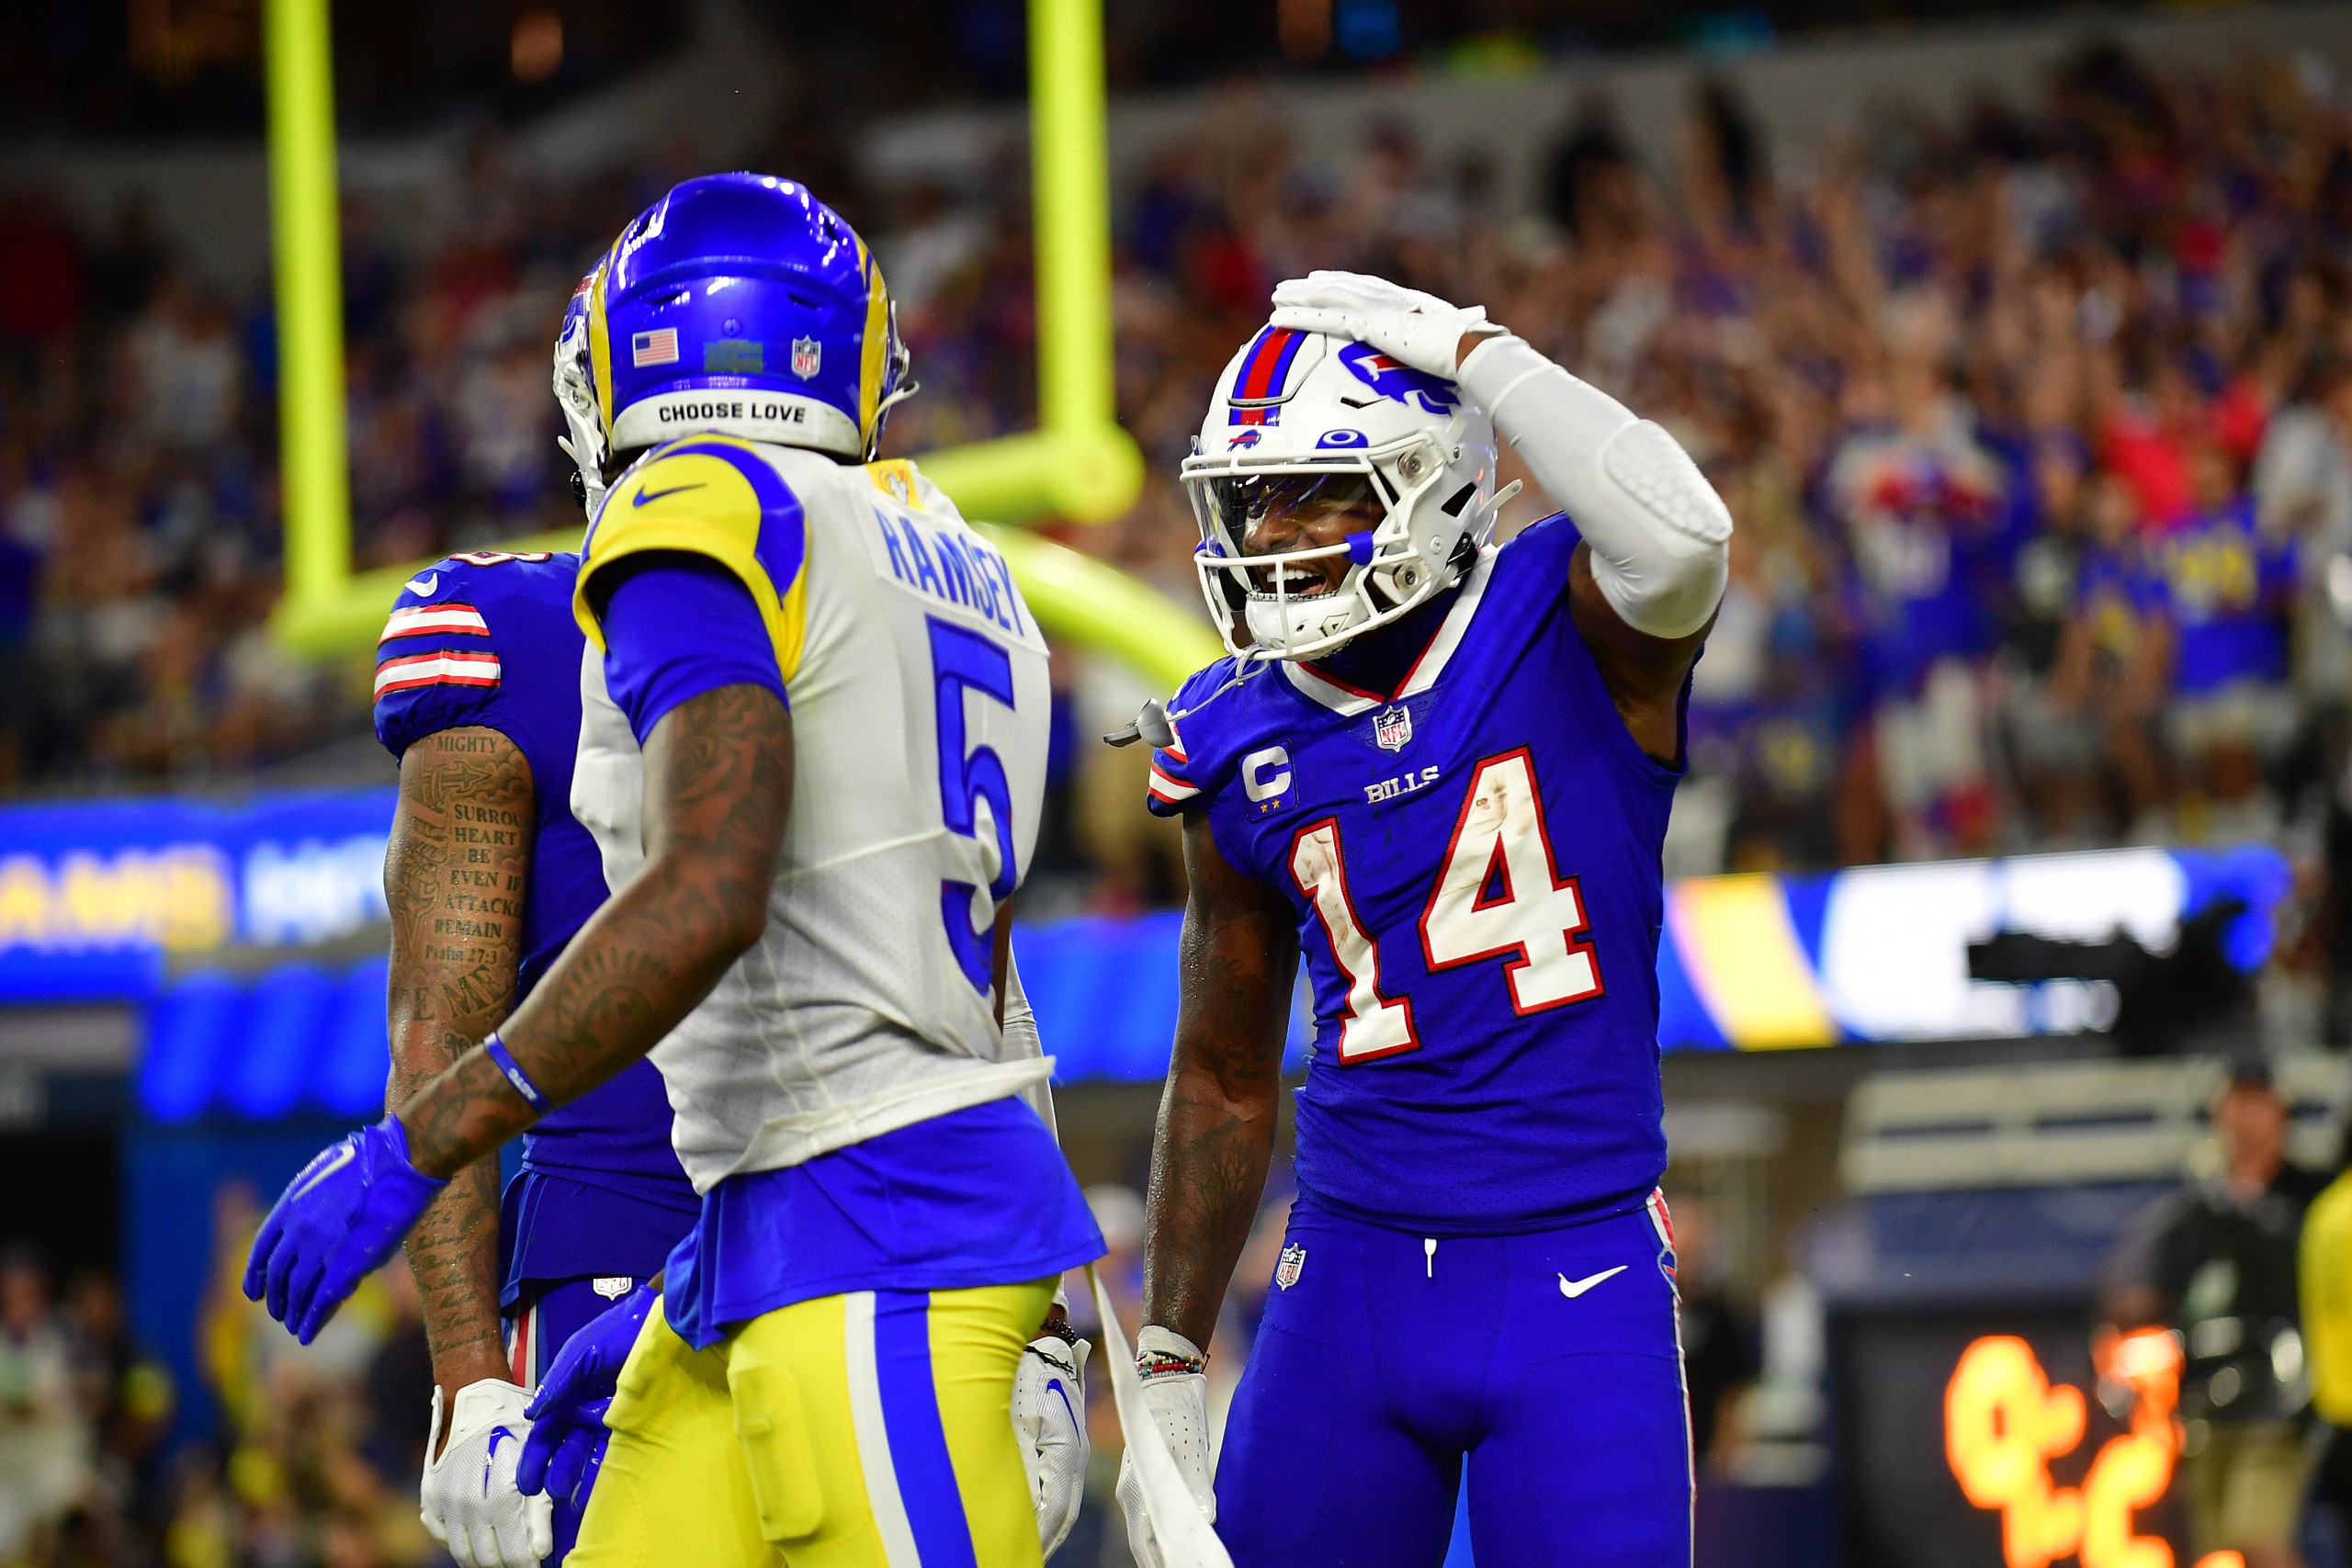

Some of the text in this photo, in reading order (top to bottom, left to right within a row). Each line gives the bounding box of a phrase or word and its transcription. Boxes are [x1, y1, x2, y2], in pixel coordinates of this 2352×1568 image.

[659, 402, 807, 423] CHOOSE LOVE
[873, 506, 1024, 637] RAMSEY
[436, 736, 497, 753] MIGHTY
[1241, 745, 1292, 803] C
[1363, 765, 1440, 804] BILLS
[924, 613, 1017, 997] 5
[455, 827, 516, 846] HEART
[469, 848, 492, 863] BE
[451, 869, 499, 887] EVEN
[1287, 743, 1607, 1066] 14
[434, 919, 503, 938] REMAIN
